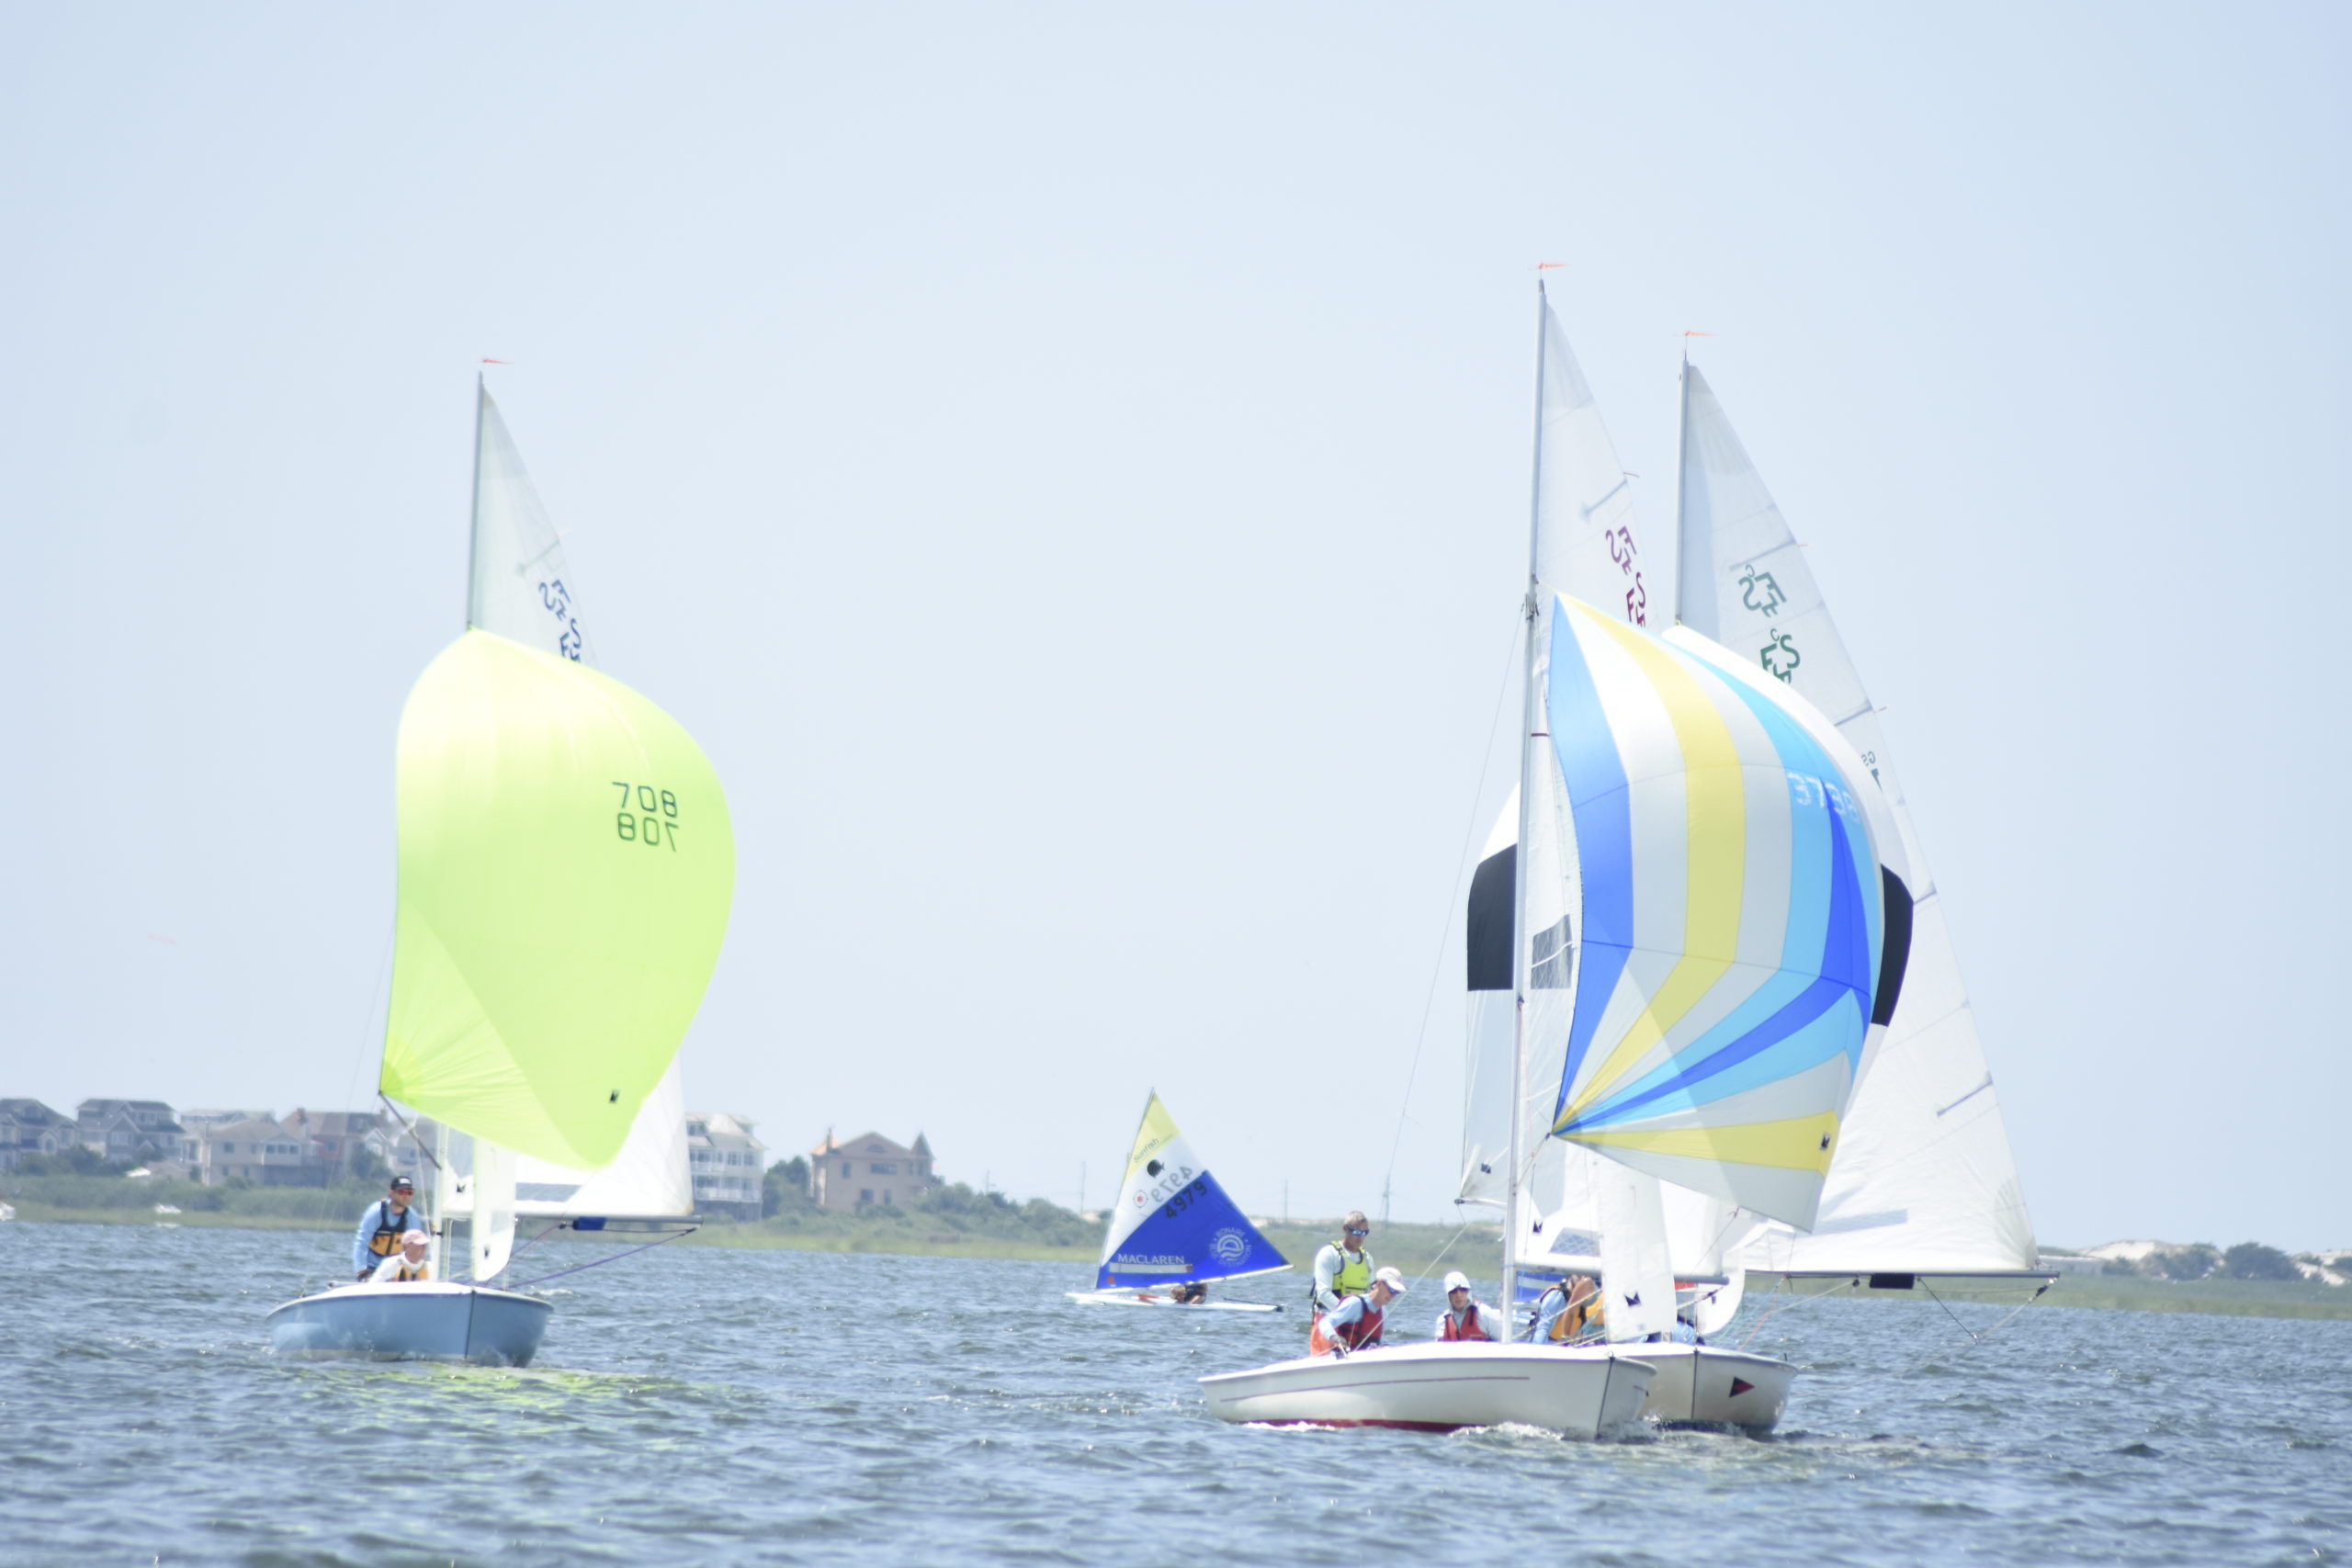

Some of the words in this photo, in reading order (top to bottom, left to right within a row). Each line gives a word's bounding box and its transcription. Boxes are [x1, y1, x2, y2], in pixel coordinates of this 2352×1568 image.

[612, 782, 678, 818] 708
[1165, 1180, 1207, 1218] 4979
[1118, 1253, 1185, 1265] MACLAREN
